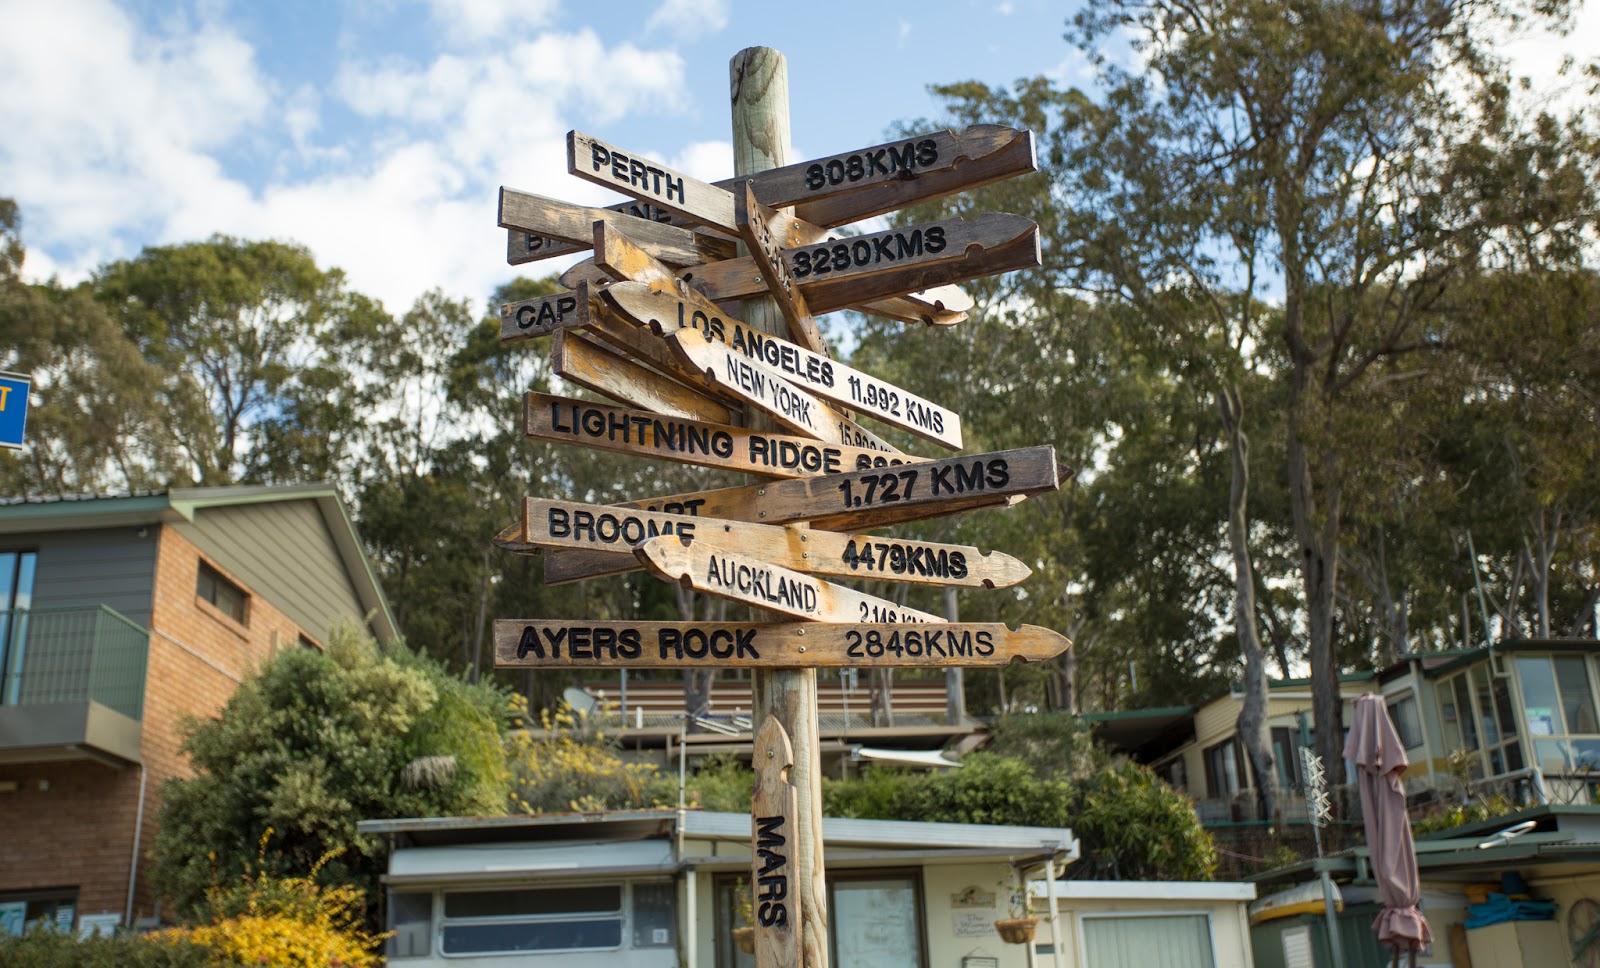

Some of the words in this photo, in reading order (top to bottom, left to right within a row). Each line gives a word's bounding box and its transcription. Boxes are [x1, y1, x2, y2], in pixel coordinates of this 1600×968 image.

[592, 143, 685, 204] PERTH
[805, 139, 938, 191] 808KMS
[792, 226, 947, 277] 3280KMS
[516, 297, 577, 329] CAP
[678, 302, 725, 343] LOS
[731, 324, 835, 388] ANGELES
[848, 375, 900, 417] 11.992
[905, 397, 944, 436] KMS
[726, 353, 765, 399] NEW
[769, 379, 813, 428] YORK
[551, 402, 734, 458] LIGHTNING
[749, 435, 842, 474] RIDGE
[839, 470, 918, 508] 1.727
[930, 459, 1010, 496] KMS
[549, 507, 695, 546] BROOME
[842, 540, 968, 579] 4479KMS
[707, 554, 817, 613] AUCKLAND
[517, 626, 642, 659] AYERS
[658, 628, 760, 660] ROCK
[845, 630, 995, 658] 2846KMS
[756, 816, 788, 928] MARS
